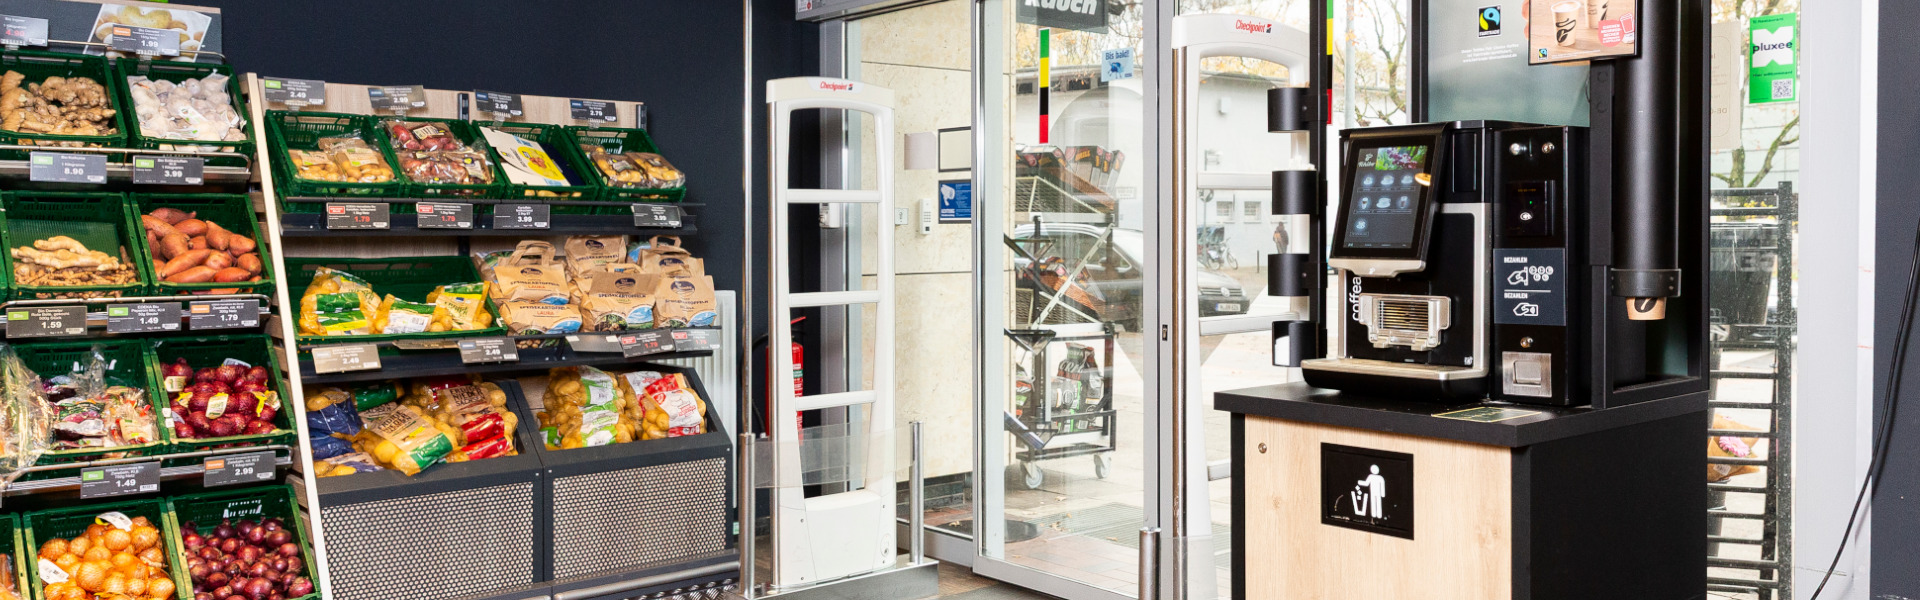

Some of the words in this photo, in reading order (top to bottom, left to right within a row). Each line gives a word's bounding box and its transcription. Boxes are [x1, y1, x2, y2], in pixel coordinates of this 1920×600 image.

[1236, 20, 1265, 34] Checkpoint
[1753, 42, 1792, 54] pluxee
[820, 81, 847, 92] Checkpoint
[1349, 277, 1362, 321] coffea
[1060, 360, 1084, 374] GRI
[235, 467, 253, 476] 2.99
[116, 479, 136, 487] 1.49
